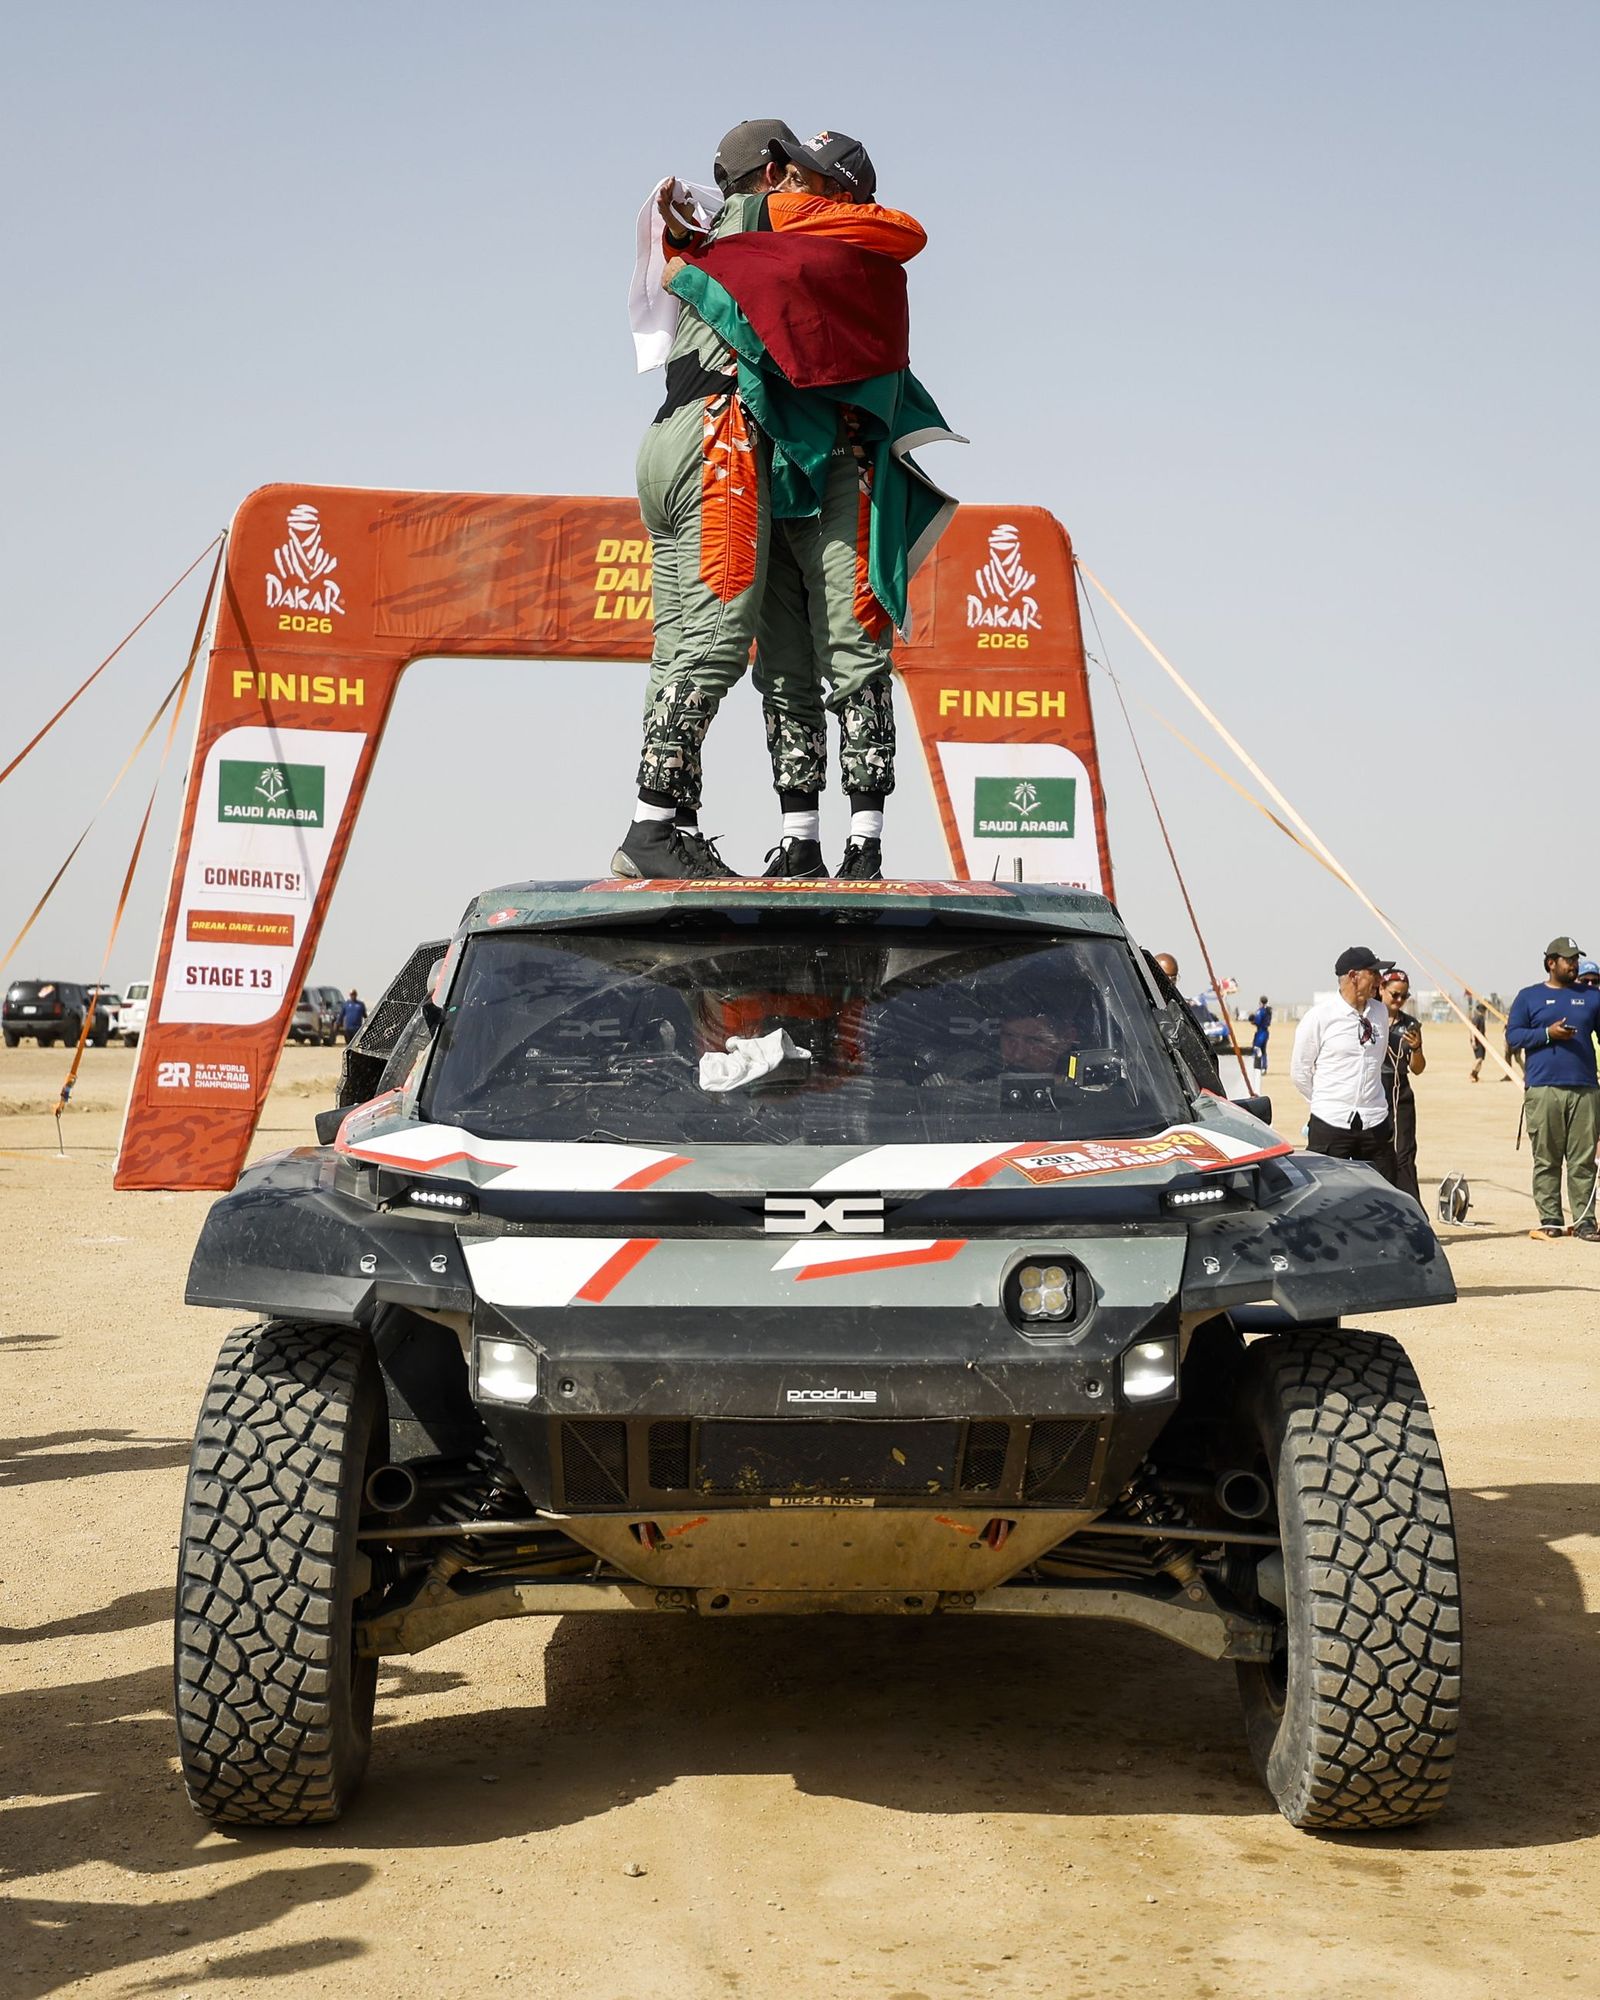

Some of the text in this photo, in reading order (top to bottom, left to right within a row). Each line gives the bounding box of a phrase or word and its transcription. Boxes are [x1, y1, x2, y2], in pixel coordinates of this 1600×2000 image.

[833, 161, 858, 186] DACIA
[265, 573, 345, 614] DAKAR
[967, 594, 1042, 630] DAKAR
[278, 614, 333, 634] 2026
[977, 633, 1029, 649] 2026
[232, 670, 365, 706] FINISH
[939, 689, 1066, 718] FINISH
[224, 804, 318, 822] SAUDI ARABIA
[979, 820, 1069, 832] SAUDI ARABIA
[204, 867, 301, 892] CONGRATS!
[191, 921, 290, 934] DREAM. DARE. LIVE IT.
[186, 966, 272, 989] STAGE 13
[195, 1070, 249, 1083] RALLY-RAID
[219, 1063, 246, 1073] WORLD
[194, 1080, 251, 1091] CHAMPIONSHIP
[1130, 1133, 1206, 1155] 2026
[1029, 1154, 1076, 1167] 299
[1056, 1145, 1195, 1175] SAUDI ARABIA
[787, 1387, 877, 1403] prodrive
